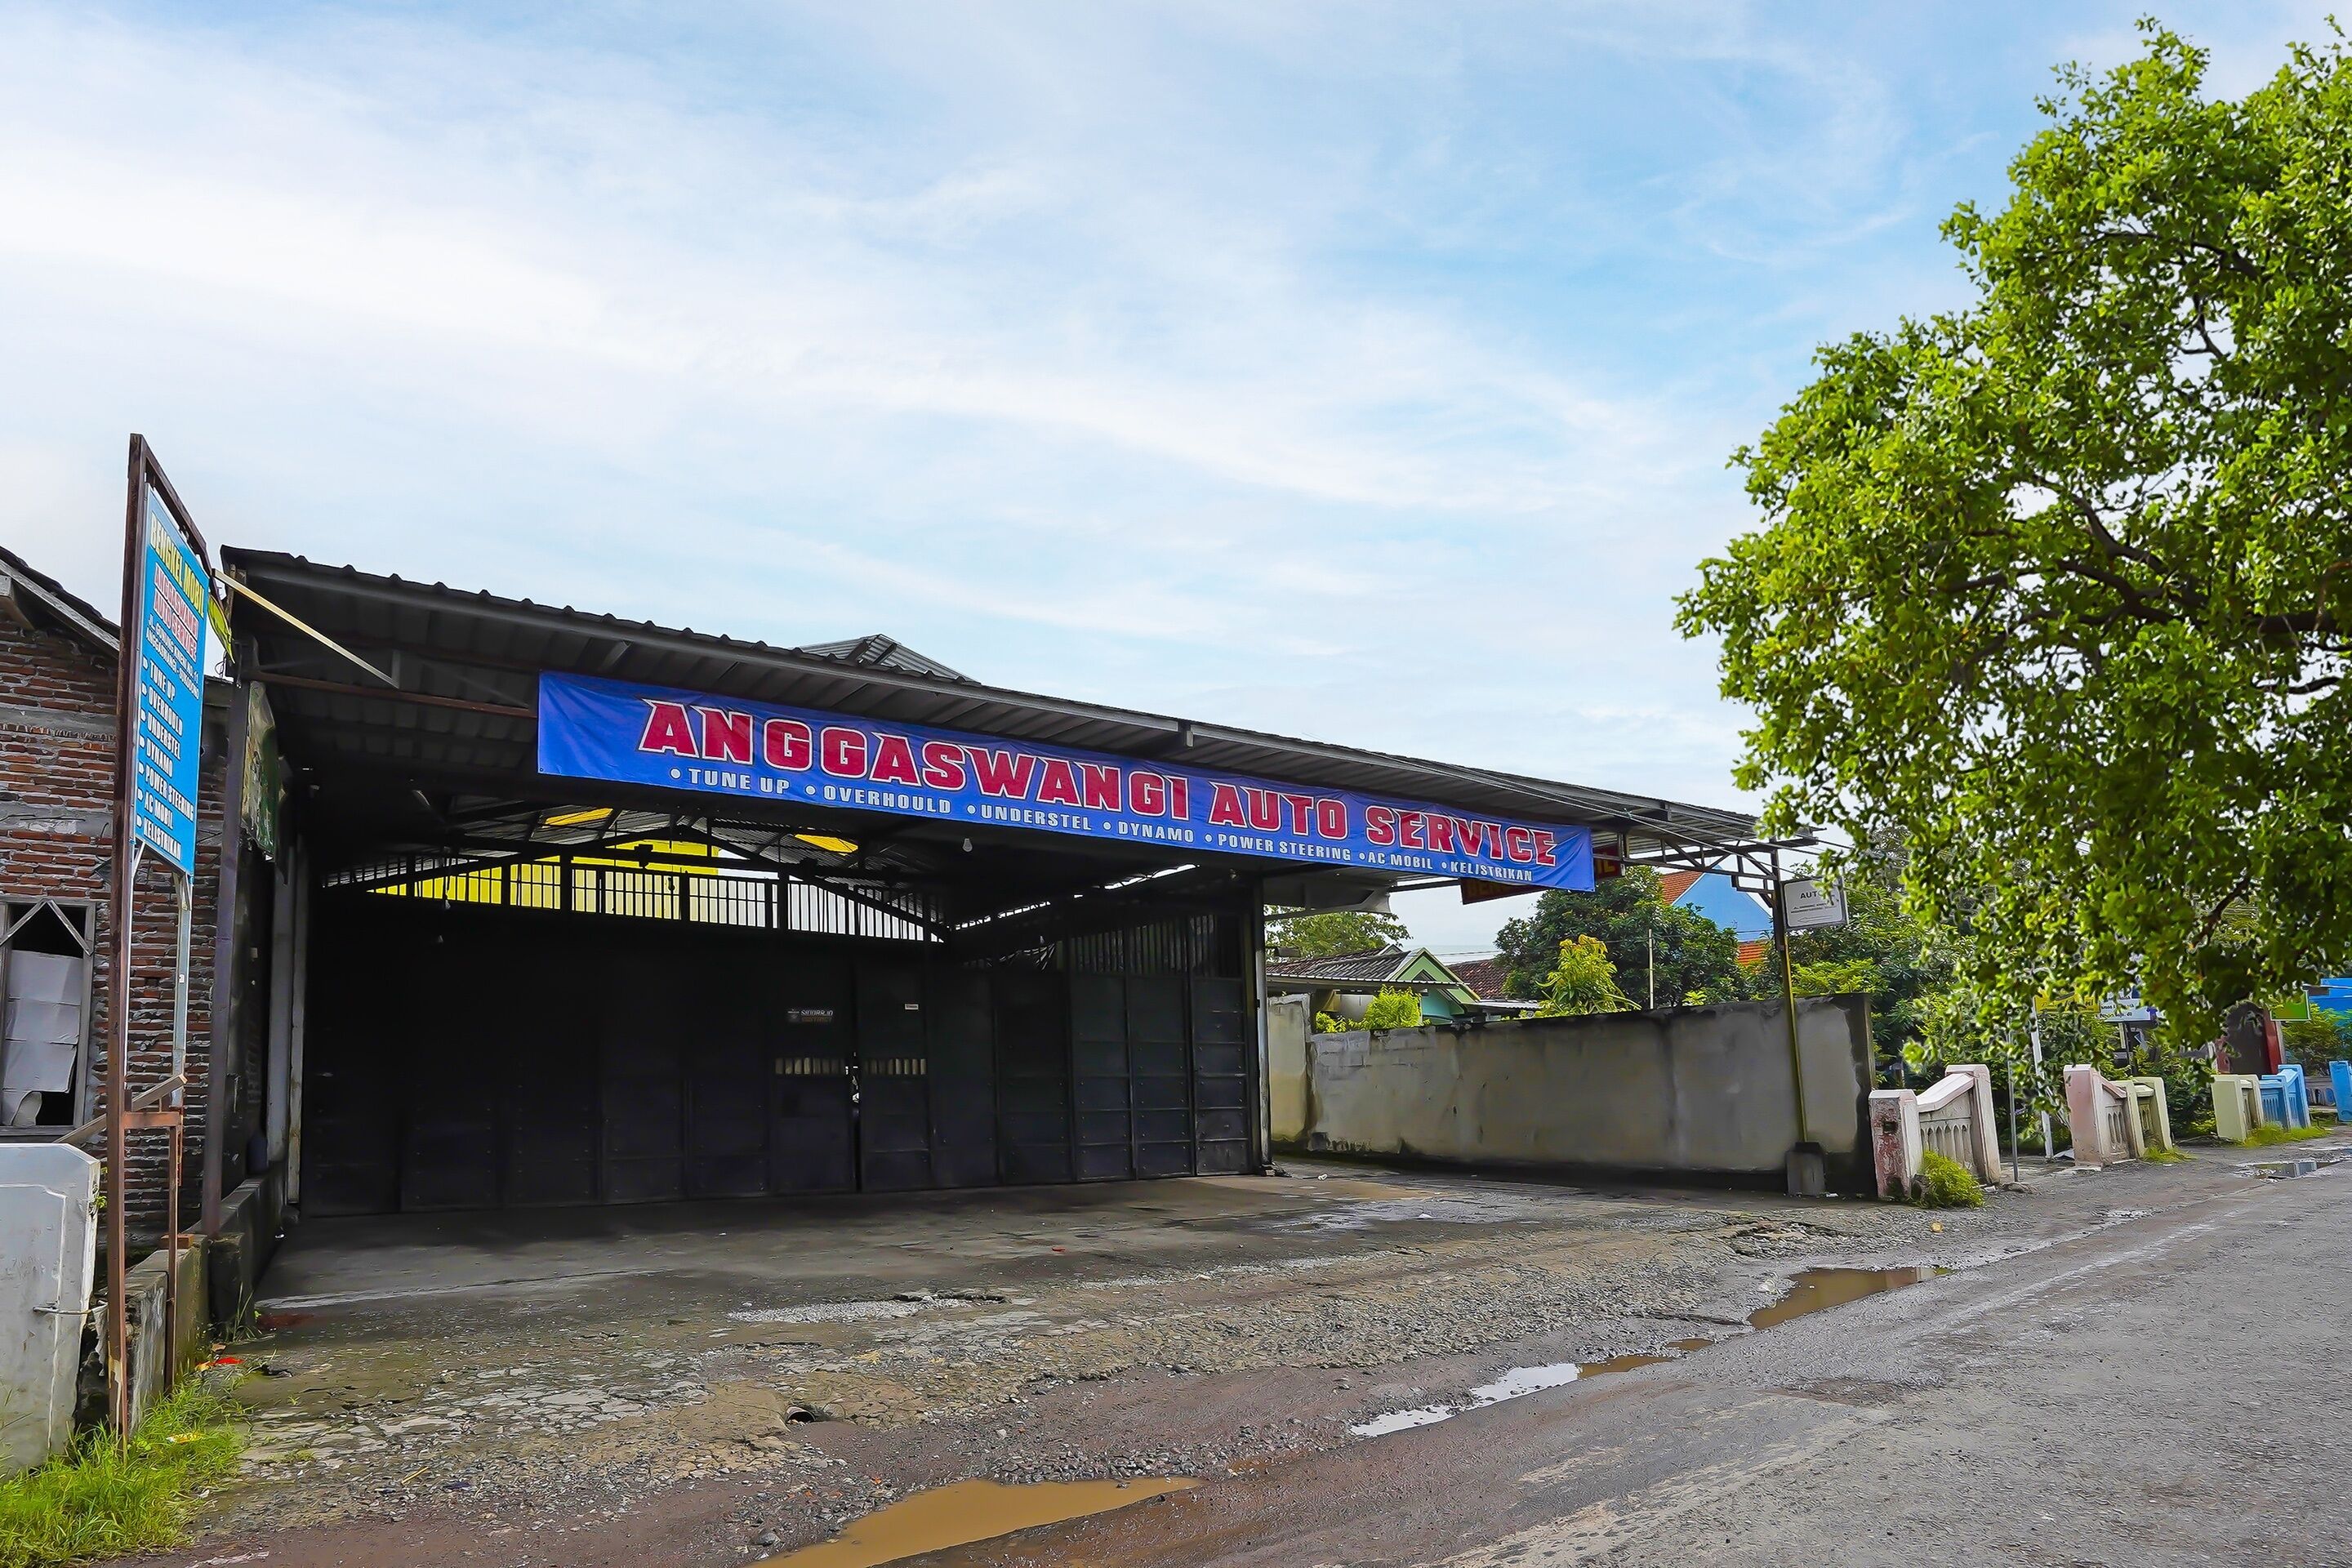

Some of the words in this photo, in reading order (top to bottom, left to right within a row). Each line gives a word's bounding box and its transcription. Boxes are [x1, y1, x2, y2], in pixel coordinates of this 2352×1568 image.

[150, 511, 183, 588] BENGKEL
[183, 561, 204, 619] MOBIL
[154, 562, 198, 641] ANGGASWANGI
[154, 588, 172, 630] AUTO
[172, 612, 198, 663] SERVICE
[149, 660, 166, 692] TUNE
[167, 679, 176, 702] UP
[147, 711, 180, 760] UNDERSTEL
[149, 686, 183, 736] OVERHOULD
[146, 737, 173, 777] DYNAMO
[639, 698, 1189, 821] ANGGASWANGI
[1209, 781, 1348, 840] AUTO
[1365, 805, 1558, 866] SERVICE
[145, 764, 167, 800] POWER
[168, 784, 194, 822] STEERING
[145, 791, 154, 814] AC
[154, 798, 173, 830] MOBIL
[144, 817, 180, 862] KELISTRIKAN
[688, 768, 751, 790] TUNE
[760, 777, 790, 795] UP
[823, 784, 951, 813] OVERHOULD
[981, 804, 1092, 831] UNDERSTEL
[1117, 821, 1194, 843] DYNAMO
[1218, 834, 1274, 852] POWER
[1279, 841, 1351, 861] STEERING
[1368, 853, 1386, 864] AC
[1391, 854, 1433, 870] MOBIL
[1450, 862, 1533, 881] KELISTRIKAN
